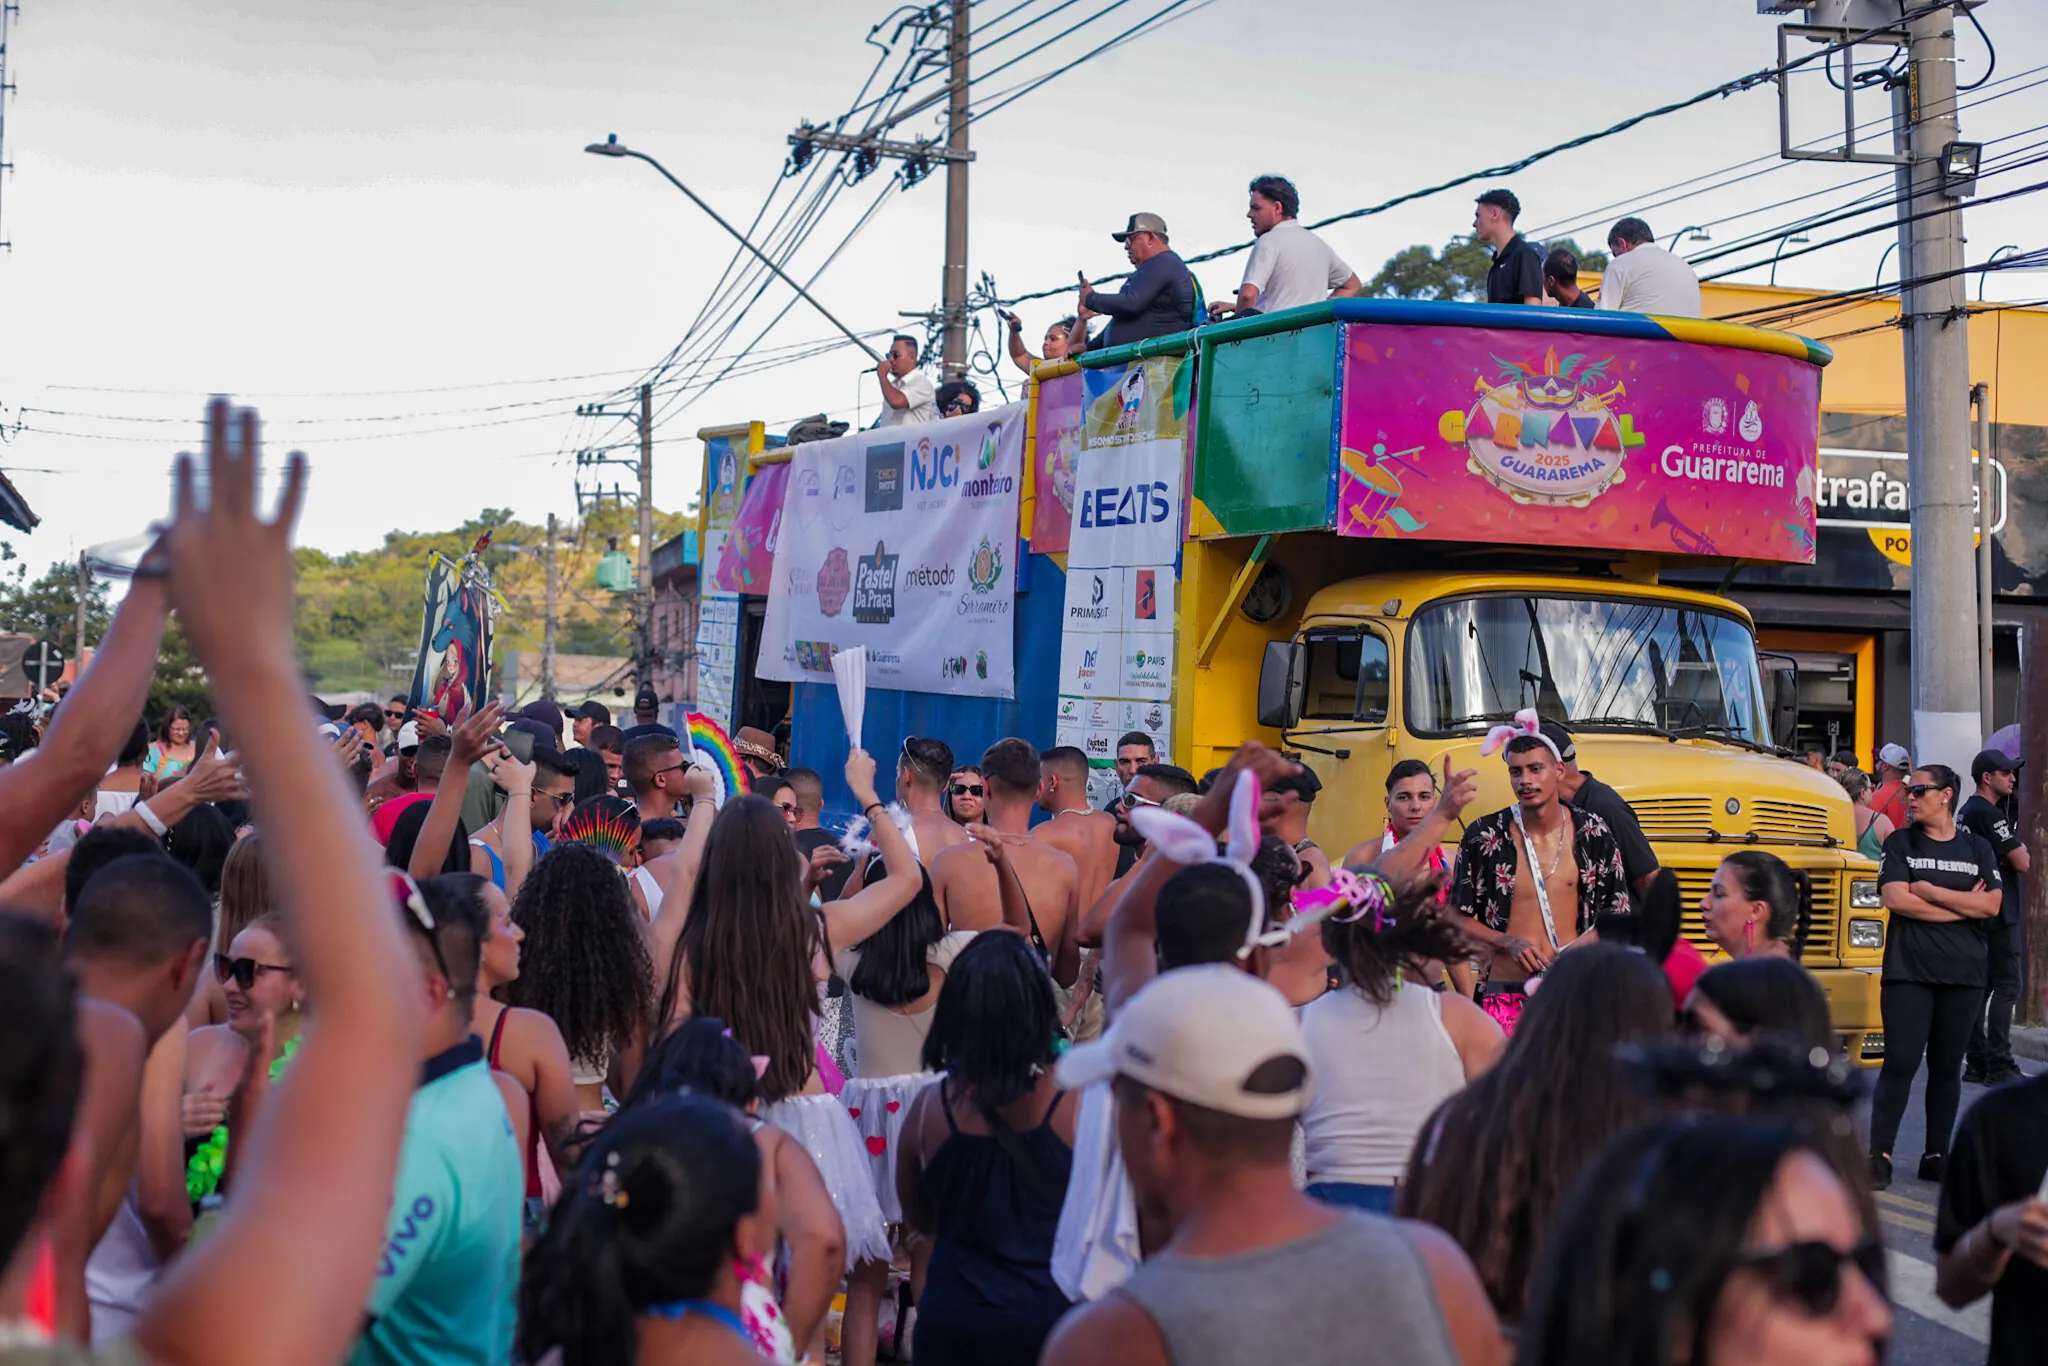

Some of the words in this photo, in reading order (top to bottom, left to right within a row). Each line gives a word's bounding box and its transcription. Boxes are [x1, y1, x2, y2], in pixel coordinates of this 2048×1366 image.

[1438, 403, 1646, 452] CARNAVAL
[1535, 453, 1570, 467] 2025
[1693, 442, 1751, 458] PREFEITURA
[1755, 449, 1767, 460] DE
[1500, 455, 1606, 481] GUARAREMA
[1661, 445, 1784, 488] Guararema
[961, 472, 1013, 498] monteiro
[857, 560, 896, 590] Pastel
[905, 563, 956, 587] método
[855, 590, 866, 608] Da
[867, 590, 893, 614] Praça
